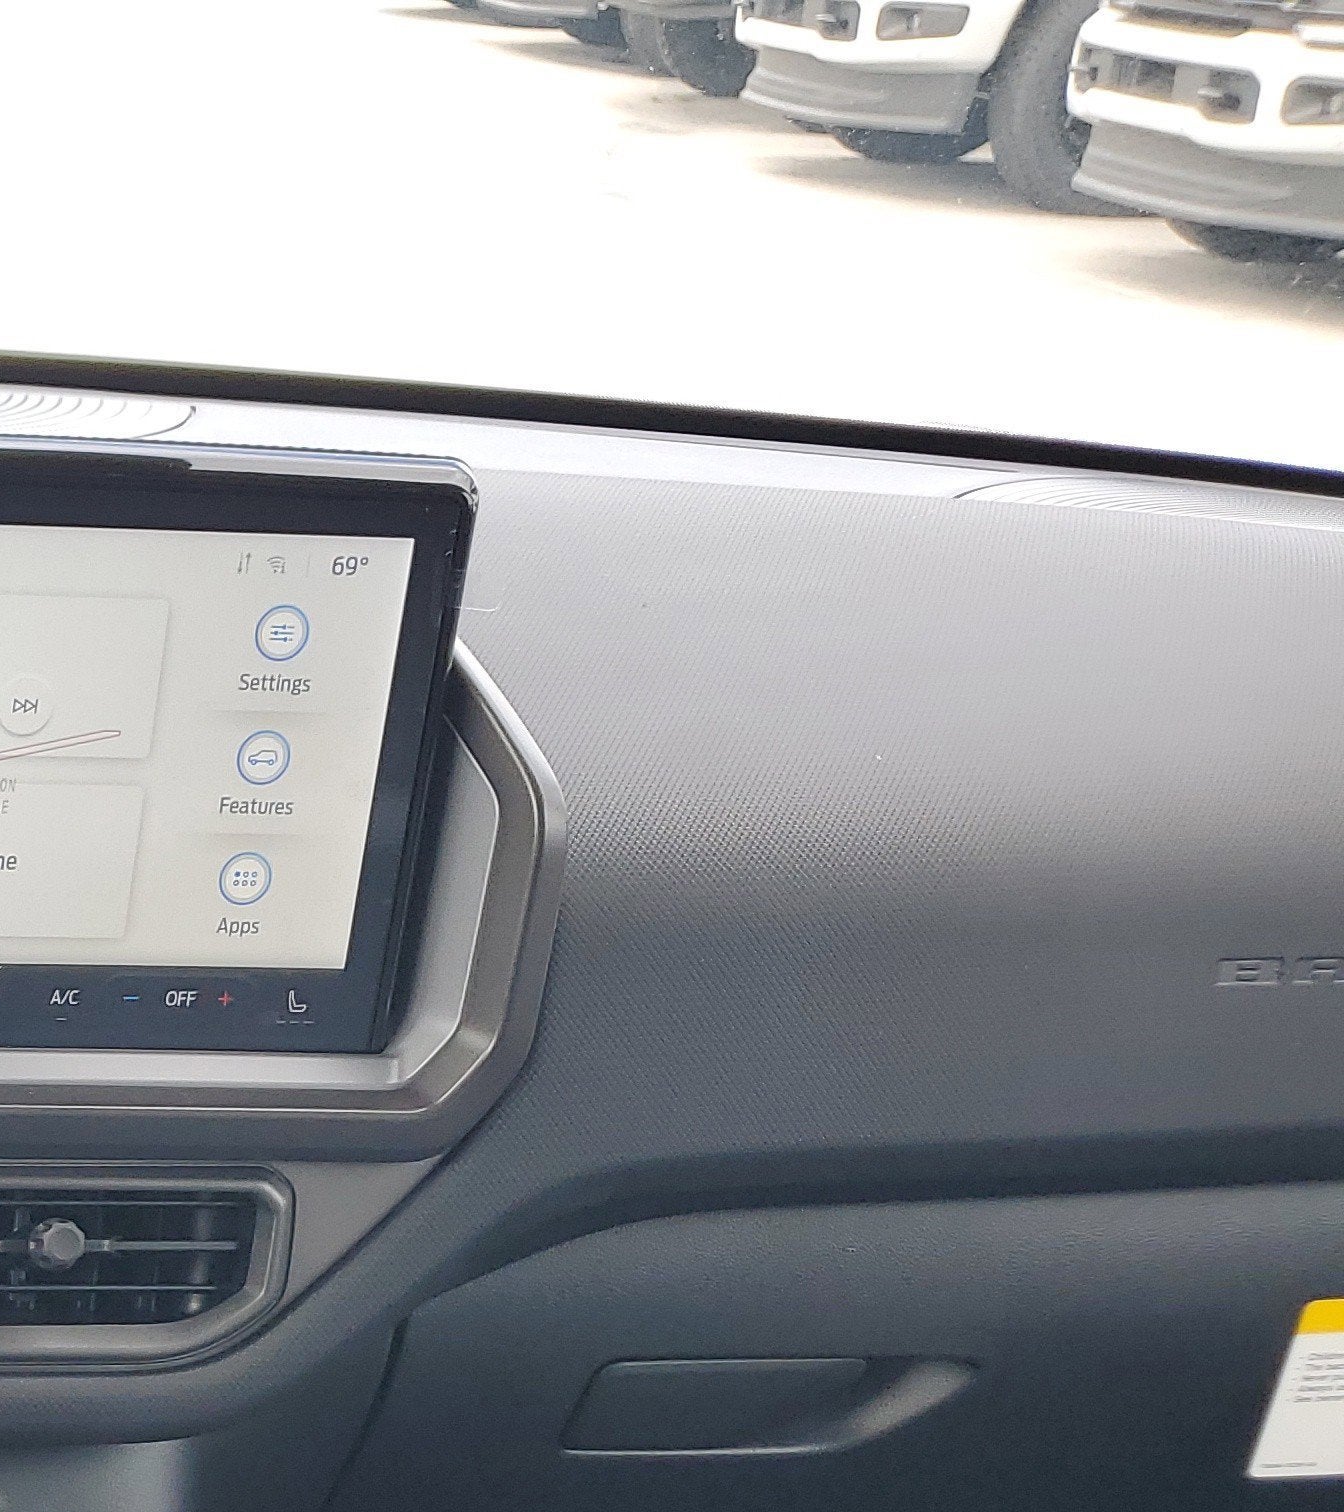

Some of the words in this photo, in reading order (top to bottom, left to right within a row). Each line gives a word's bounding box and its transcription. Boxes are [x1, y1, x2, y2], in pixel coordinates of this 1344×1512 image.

[238, 673, 311, 695] Settings
[219, 796, 294, 816] Features
[216, 917, 260, 937] Apps
[50, 989, 80, 1006] A/C
[165, 989, 198, 1008] OFF
